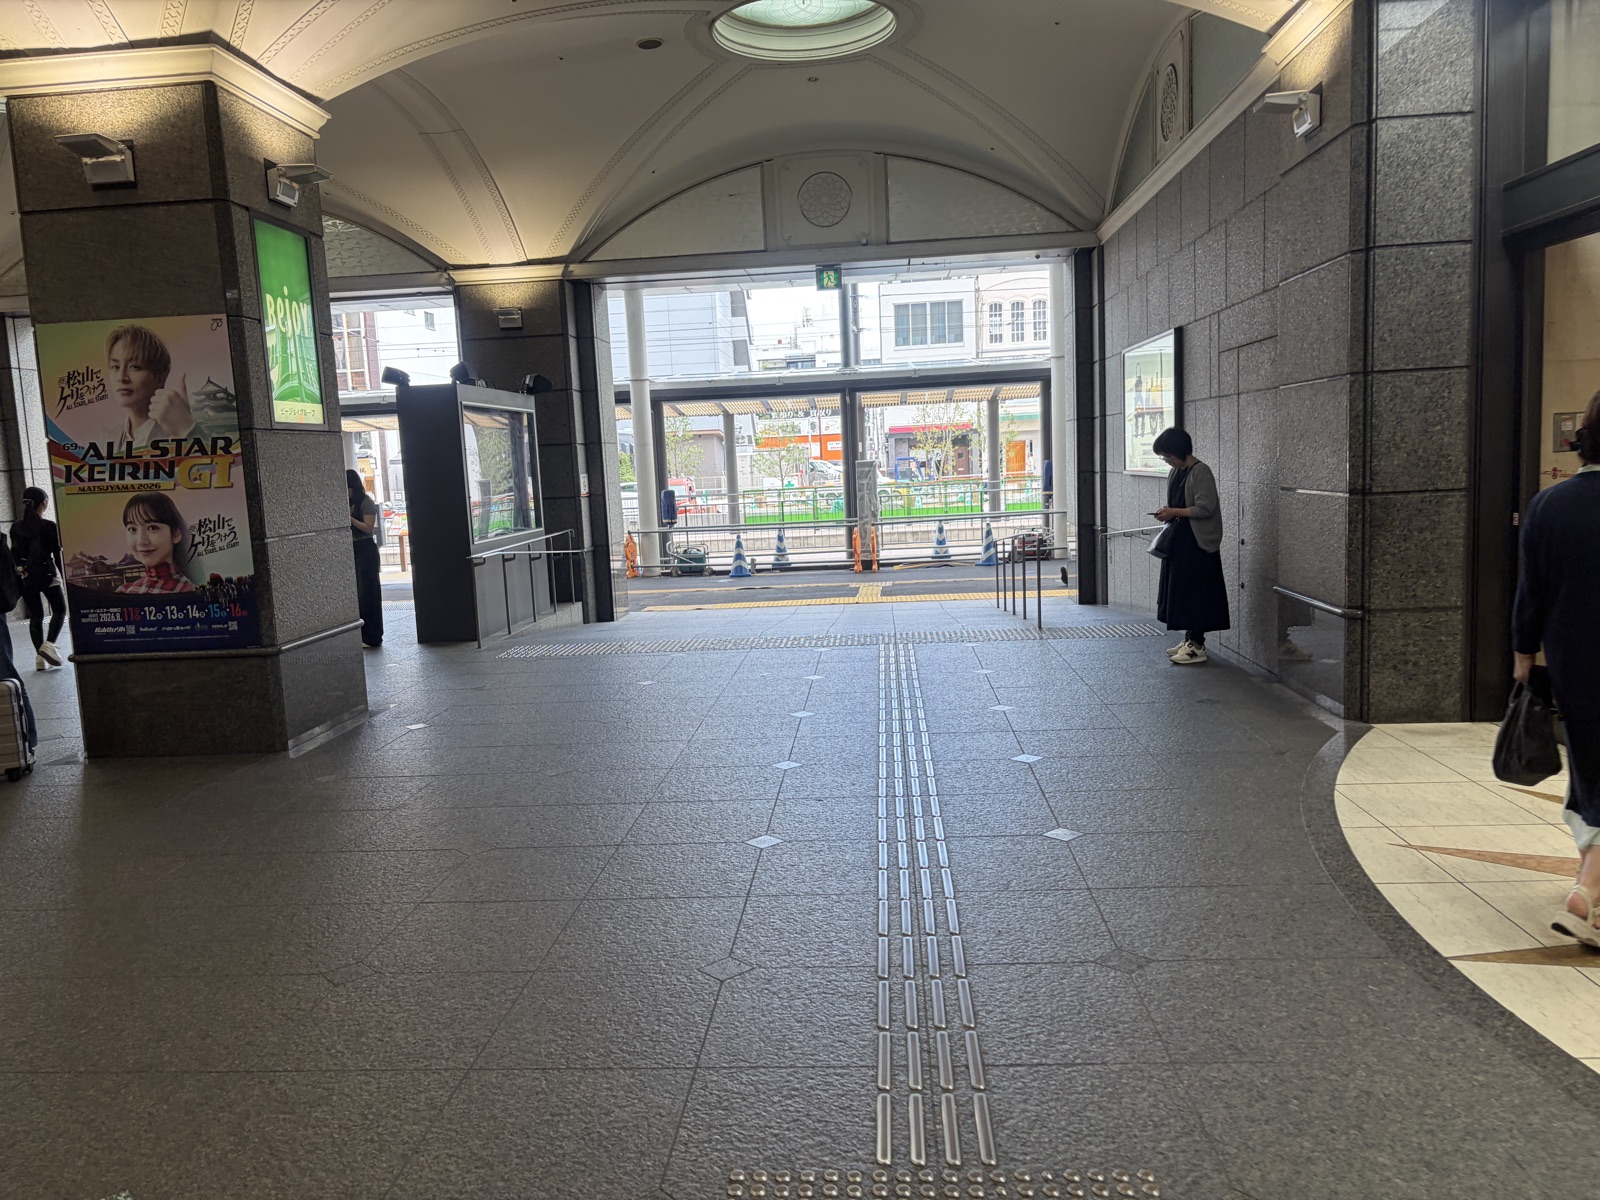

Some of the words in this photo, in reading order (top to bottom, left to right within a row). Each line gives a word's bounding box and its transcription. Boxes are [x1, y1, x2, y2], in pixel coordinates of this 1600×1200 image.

[80, 440, 143, 461] ALL
[150, 436, 233, 458] STAR
[64, 459, 175, 483] KEIRIN
[77, 483, 137, 493] MATSUYAMA
[137, 482, 161, 490] 2026
